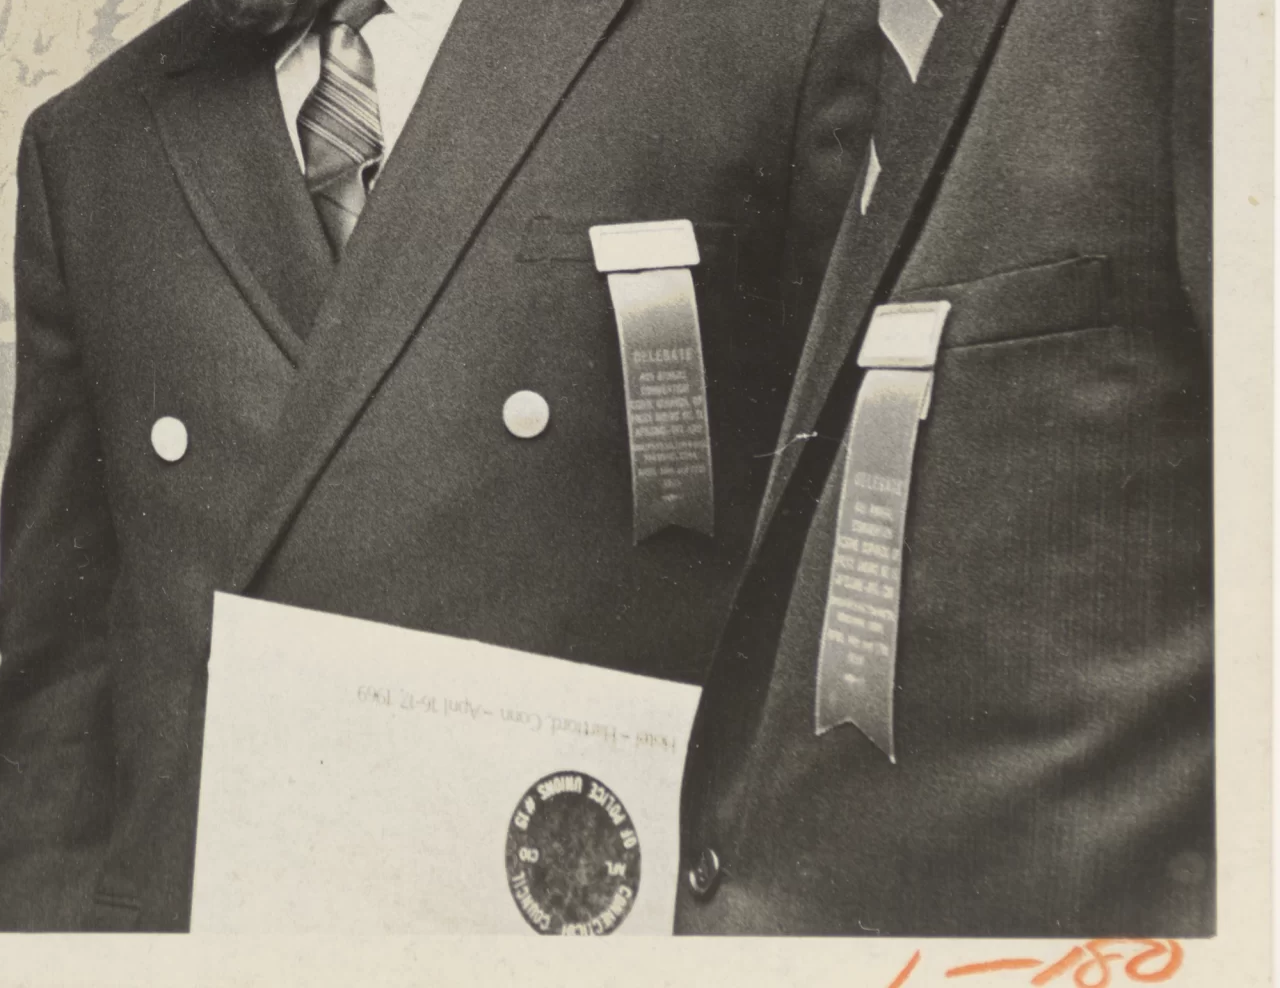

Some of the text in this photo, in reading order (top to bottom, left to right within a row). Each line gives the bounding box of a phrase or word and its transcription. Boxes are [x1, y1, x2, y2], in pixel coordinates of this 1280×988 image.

[356, 684, 392, 709] 1969
[536, 775, 583, 801] UNIONS
[586, 781, 626, 825] POLICE
[619, 829, 638, 849] OF
[511, 869, 551, 931] COUNCIL
